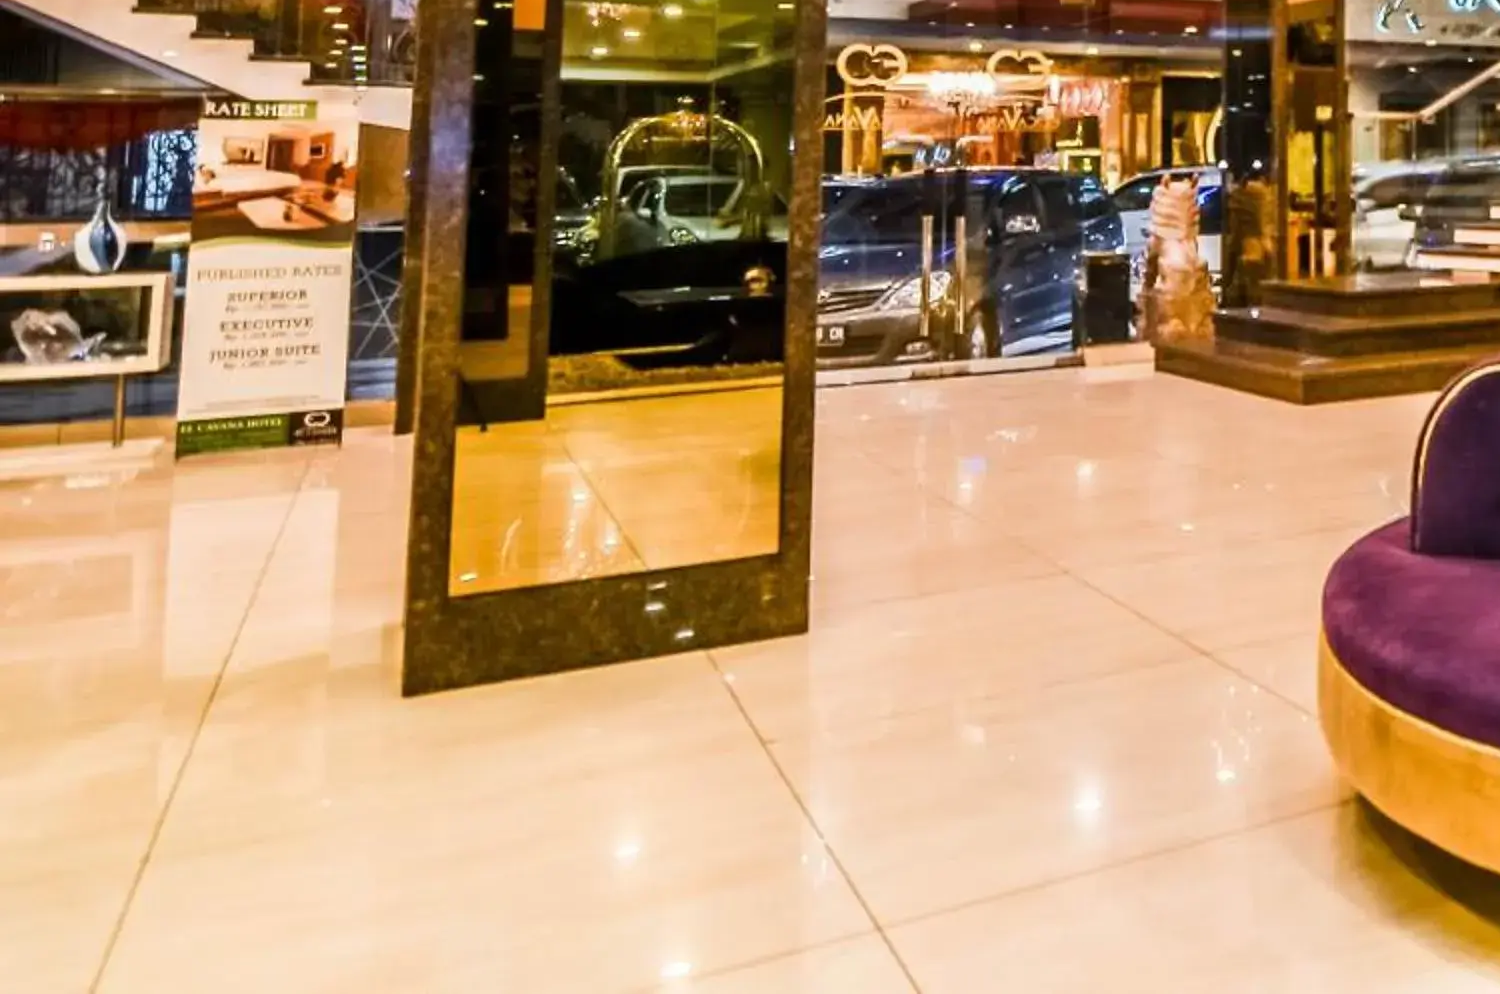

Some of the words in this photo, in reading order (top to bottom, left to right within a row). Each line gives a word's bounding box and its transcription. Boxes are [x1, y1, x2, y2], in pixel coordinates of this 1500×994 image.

[205, 101, 250, 117] RATE
[254, 101, 308, 117] SHEET
[197, 267, 287, 282] PUBLISHED
[292, 264, 342, 278] RATES
[227, 290, 308, 303] SUPERIOR
[220, 317, 314, 333] EXECUTIVE
[209, 348, 270, 364] JUNIOR
[275, 344, 321, 356] SUITE
